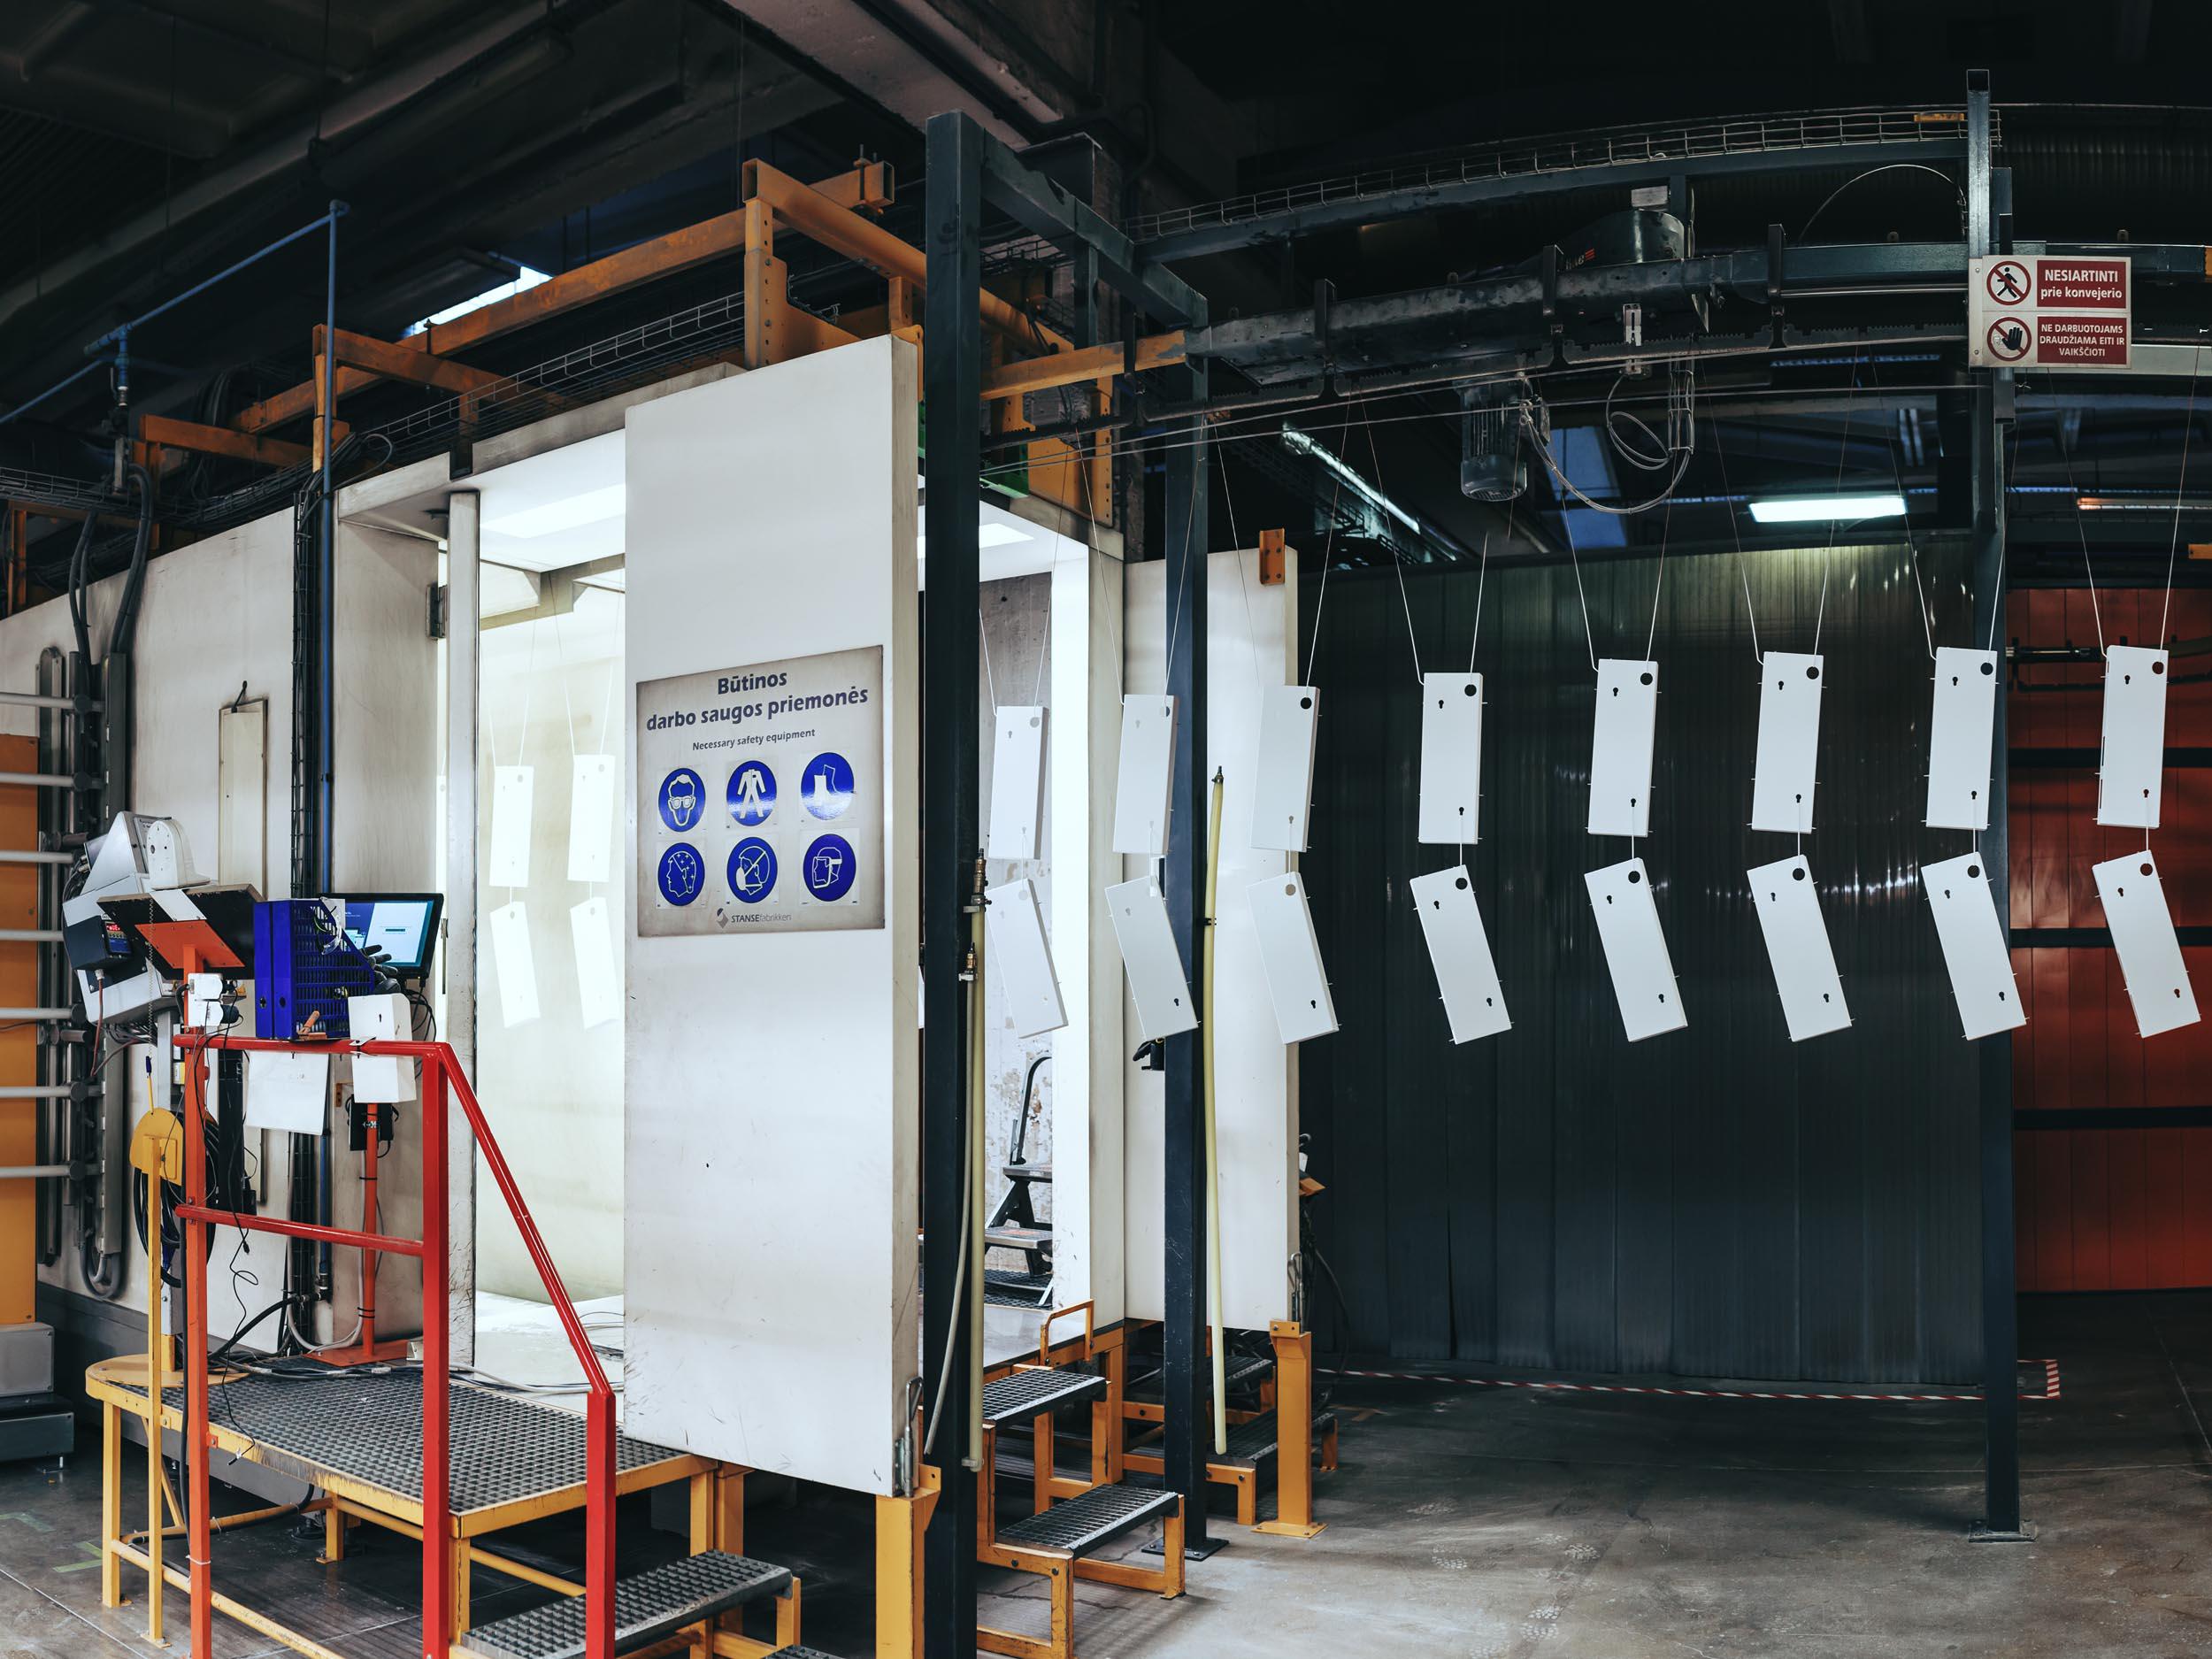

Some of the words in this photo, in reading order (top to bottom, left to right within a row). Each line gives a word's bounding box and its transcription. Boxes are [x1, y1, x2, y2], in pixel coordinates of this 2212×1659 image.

[2045, 269, 2118, 282] NESIARTINTI
[2040, 287, 2062, 300] prie
[2064, 287, 2123, 301] konvejerio
[2041, 324, 2053, 333] NE
[2055, 325, 2124, 334] DARBUOTOJAMS
[2039, 334, 2097, 345] DRAUDŽIAMA
[2099, 336, 2114, 345] EITI
[2116, 337, 2124, 346] IR
[2059, 346, 2106, 356] VAIKŠČIOTI
[718, 672, 787, 695] Būtinos
[646, 711, 696, 731] darbo
[701, 703, 763, 725] saugos
[768, 687, 868, 719] priemonės
[692, 737, 735, 750] Necessary
[737, 733, 764, 746] safety
[766, 728, 815, 744] equipment
